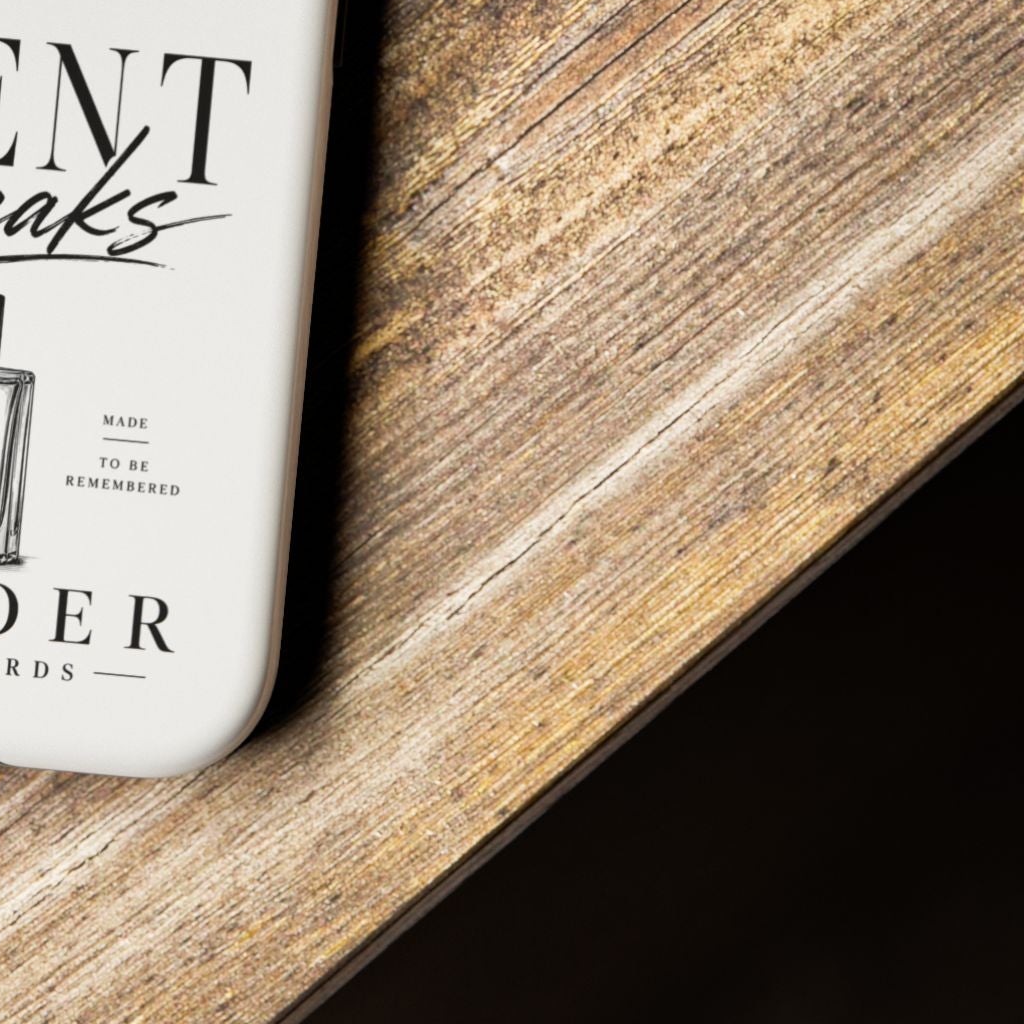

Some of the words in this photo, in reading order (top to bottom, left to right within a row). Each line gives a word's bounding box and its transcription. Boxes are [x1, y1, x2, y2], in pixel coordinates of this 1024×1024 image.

[103, 414, 149, 429] MADE
[99, 457, 121, 469] TO
[129, 459, 149, 472] BE
[65, 475, 181, 496] REMEMBERED
